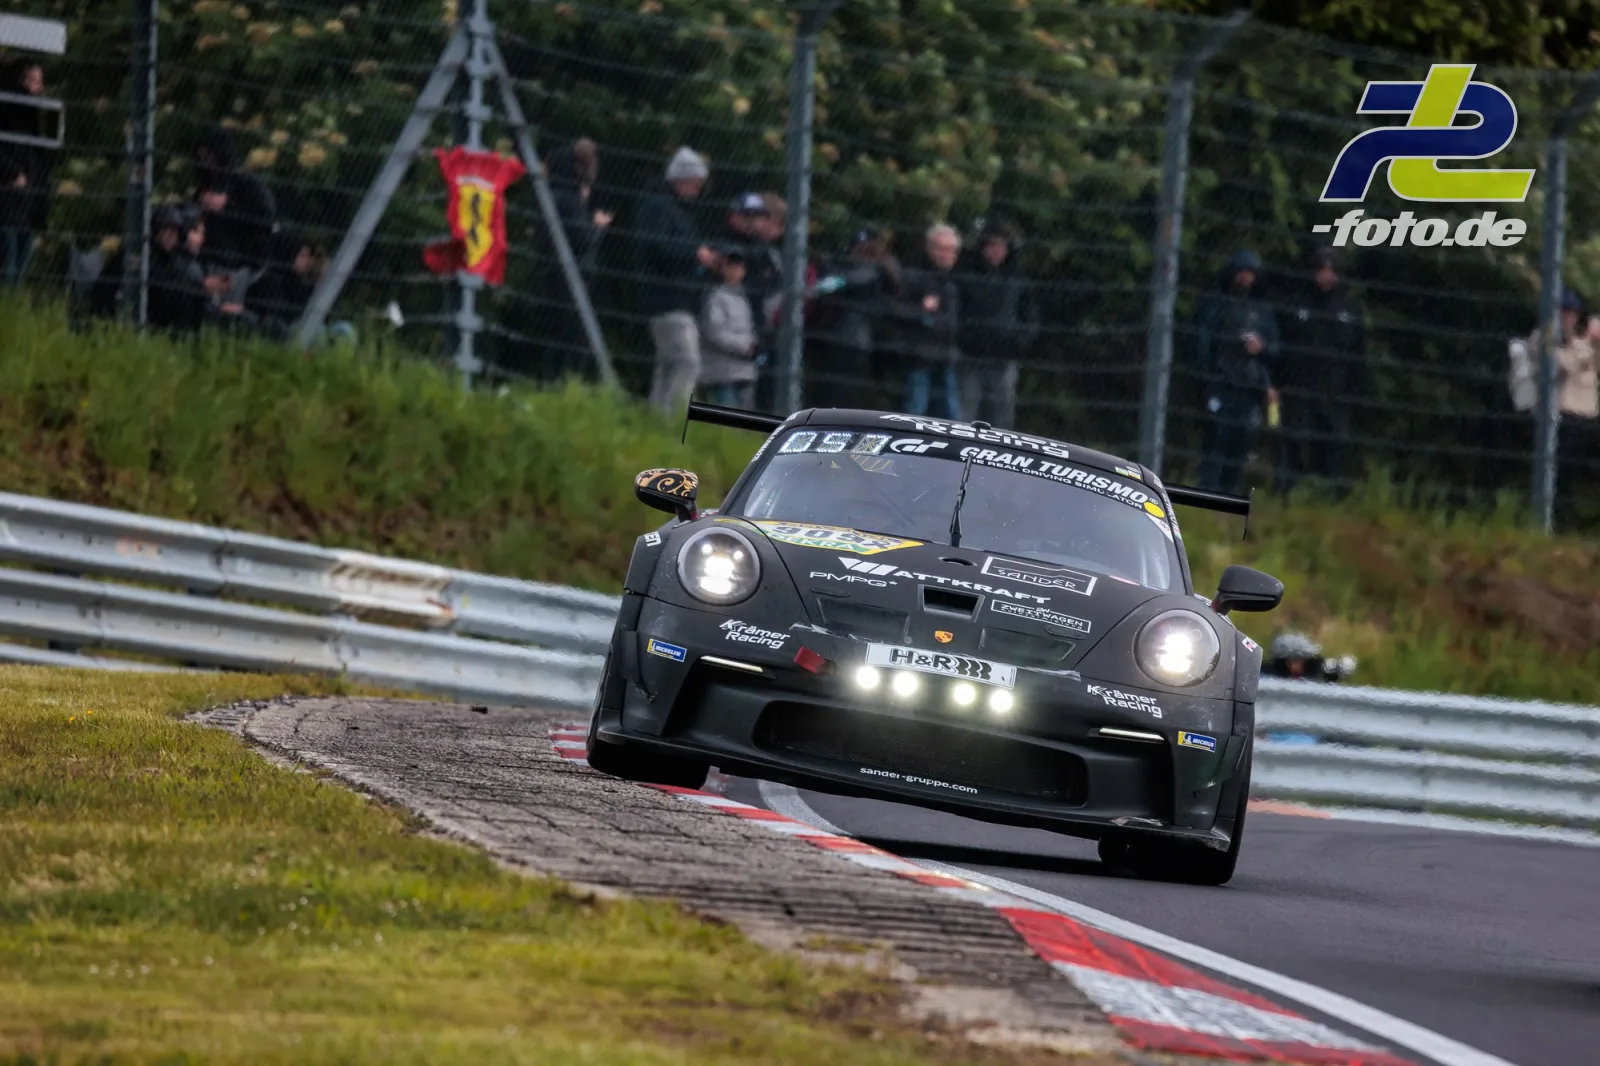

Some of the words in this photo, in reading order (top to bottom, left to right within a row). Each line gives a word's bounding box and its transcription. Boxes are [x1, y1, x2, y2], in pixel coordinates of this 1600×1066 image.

[960, 447, 1034, 468] GRAN
[1040, 462, 1149, 504] TURISMO
[988, 460, 1019, 472] REAL
[1023, 468, 1071, 484] DRIVING
[997, 570, 1077, 590] SANDER
[719, 619, 791, 640] Krämer
[725, 631, 785, 649] Racing
[890, 648, 953, 671] H&R
[1087, 685, 1157, 705] Krämer
[1103, 696, 1163, 719] Racing
[860, 767, 978, 794] sander-gruppe.com
